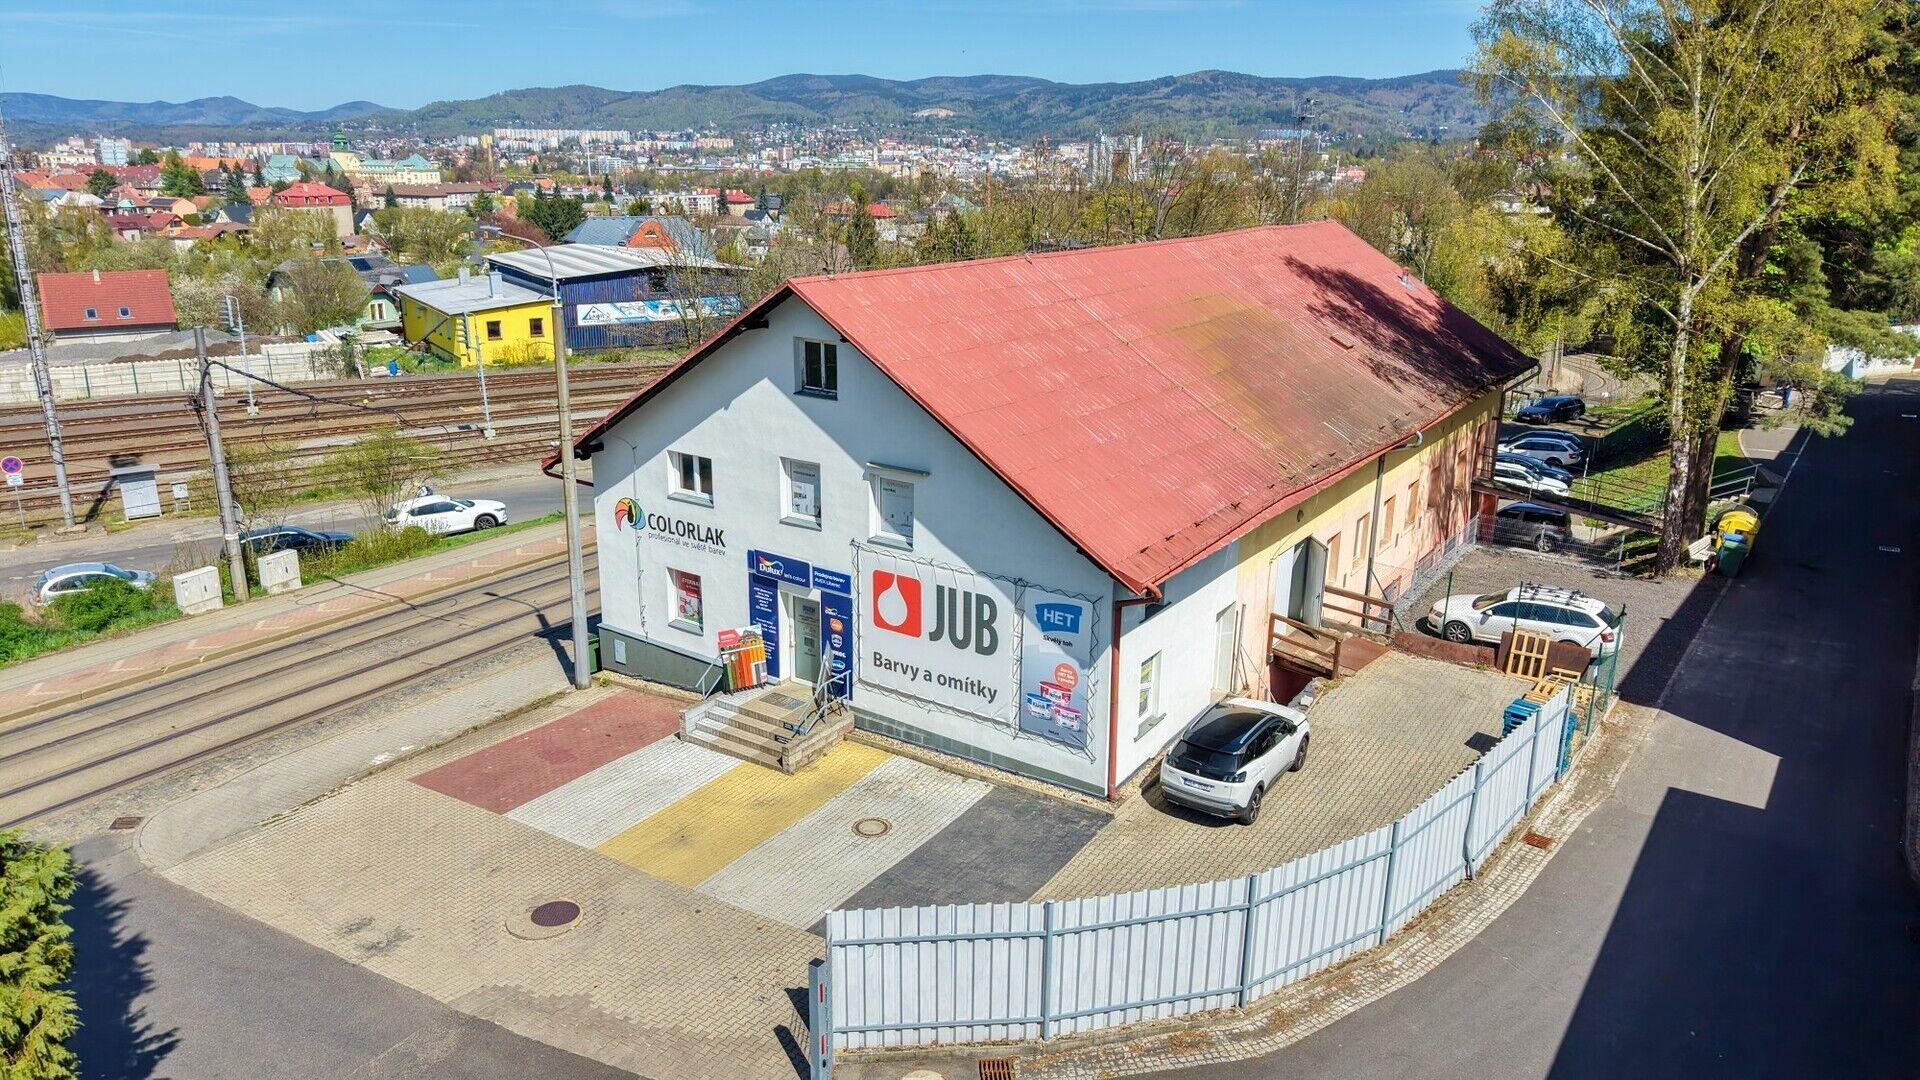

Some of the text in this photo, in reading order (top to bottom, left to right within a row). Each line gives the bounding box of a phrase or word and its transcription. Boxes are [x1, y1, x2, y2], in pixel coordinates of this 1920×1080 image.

[647, 513, 726, 548] COLORLAK
[759, 563, 782, 575] Dulux
[929, 584, 999, 656] JUB
[1043, 608, 1075, 628] HET
[873, 651, 998, 703] Barvy a omítky
